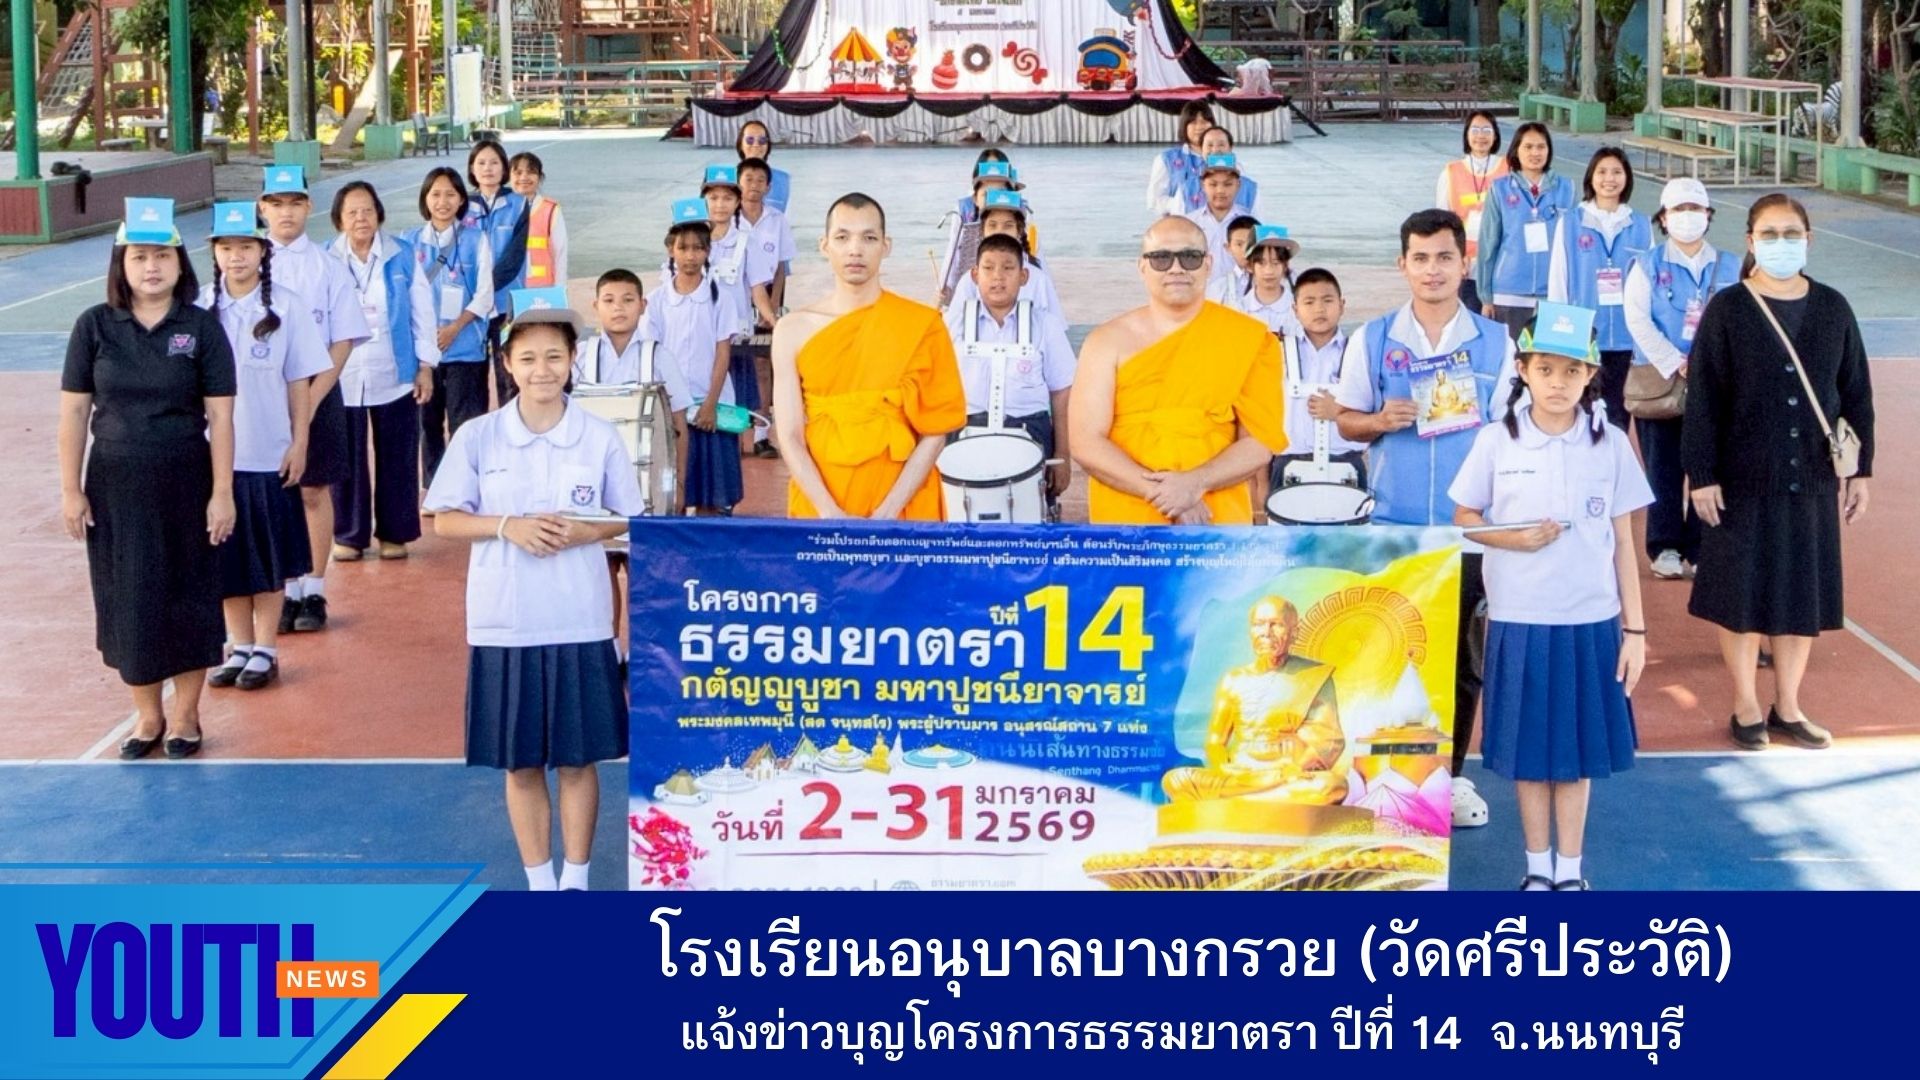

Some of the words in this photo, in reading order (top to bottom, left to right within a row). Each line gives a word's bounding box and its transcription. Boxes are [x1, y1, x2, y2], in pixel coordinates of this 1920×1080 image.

[684, 580, 817, 614] โครงการ
[990, 601, 1019, 626] ปีที่
[680, 625, 1025, 668] ธรรมยาตรา
[1025, 585, 1154, 671] 14
[681, 667, 860, 711] กตัญญูบูชา
[876, 672, 1146, 714] มหาปูชนียาจารย์
[1103, 721, 1112, 732] 7
[712, 800, 783, 841] วันที่
[799, 781, 964, 841] 2-31
[976, 784, 1095, 805] มกราคม
[975, 810, 1095, 842] 2569
